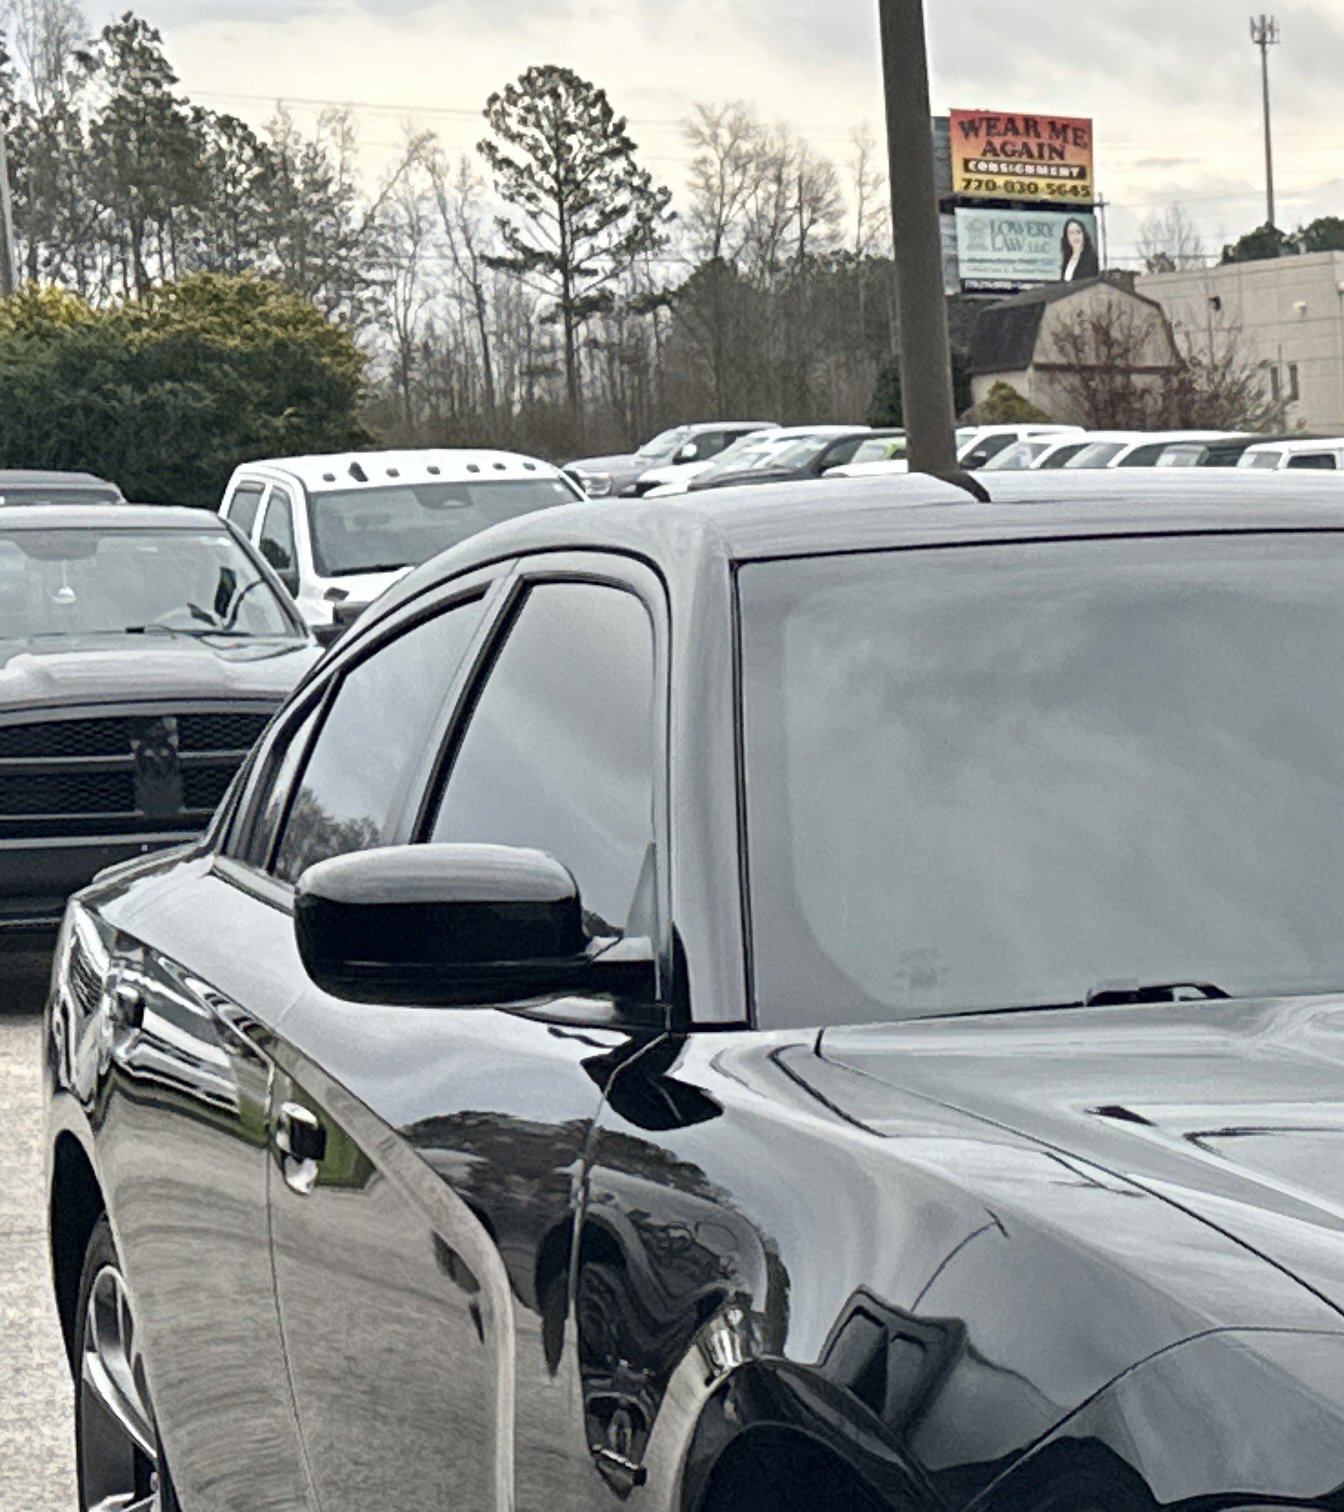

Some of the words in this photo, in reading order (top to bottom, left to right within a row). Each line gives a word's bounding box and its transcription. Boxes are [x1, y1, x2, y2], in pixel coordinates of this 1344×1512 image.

[957, 116, 1042, 141] WEAR
[1047, 120, 1089, 150] ME
[981, 139, 1066, 161] AGAIN
[968, 160, 1080, 177] CONSIGNMENT
